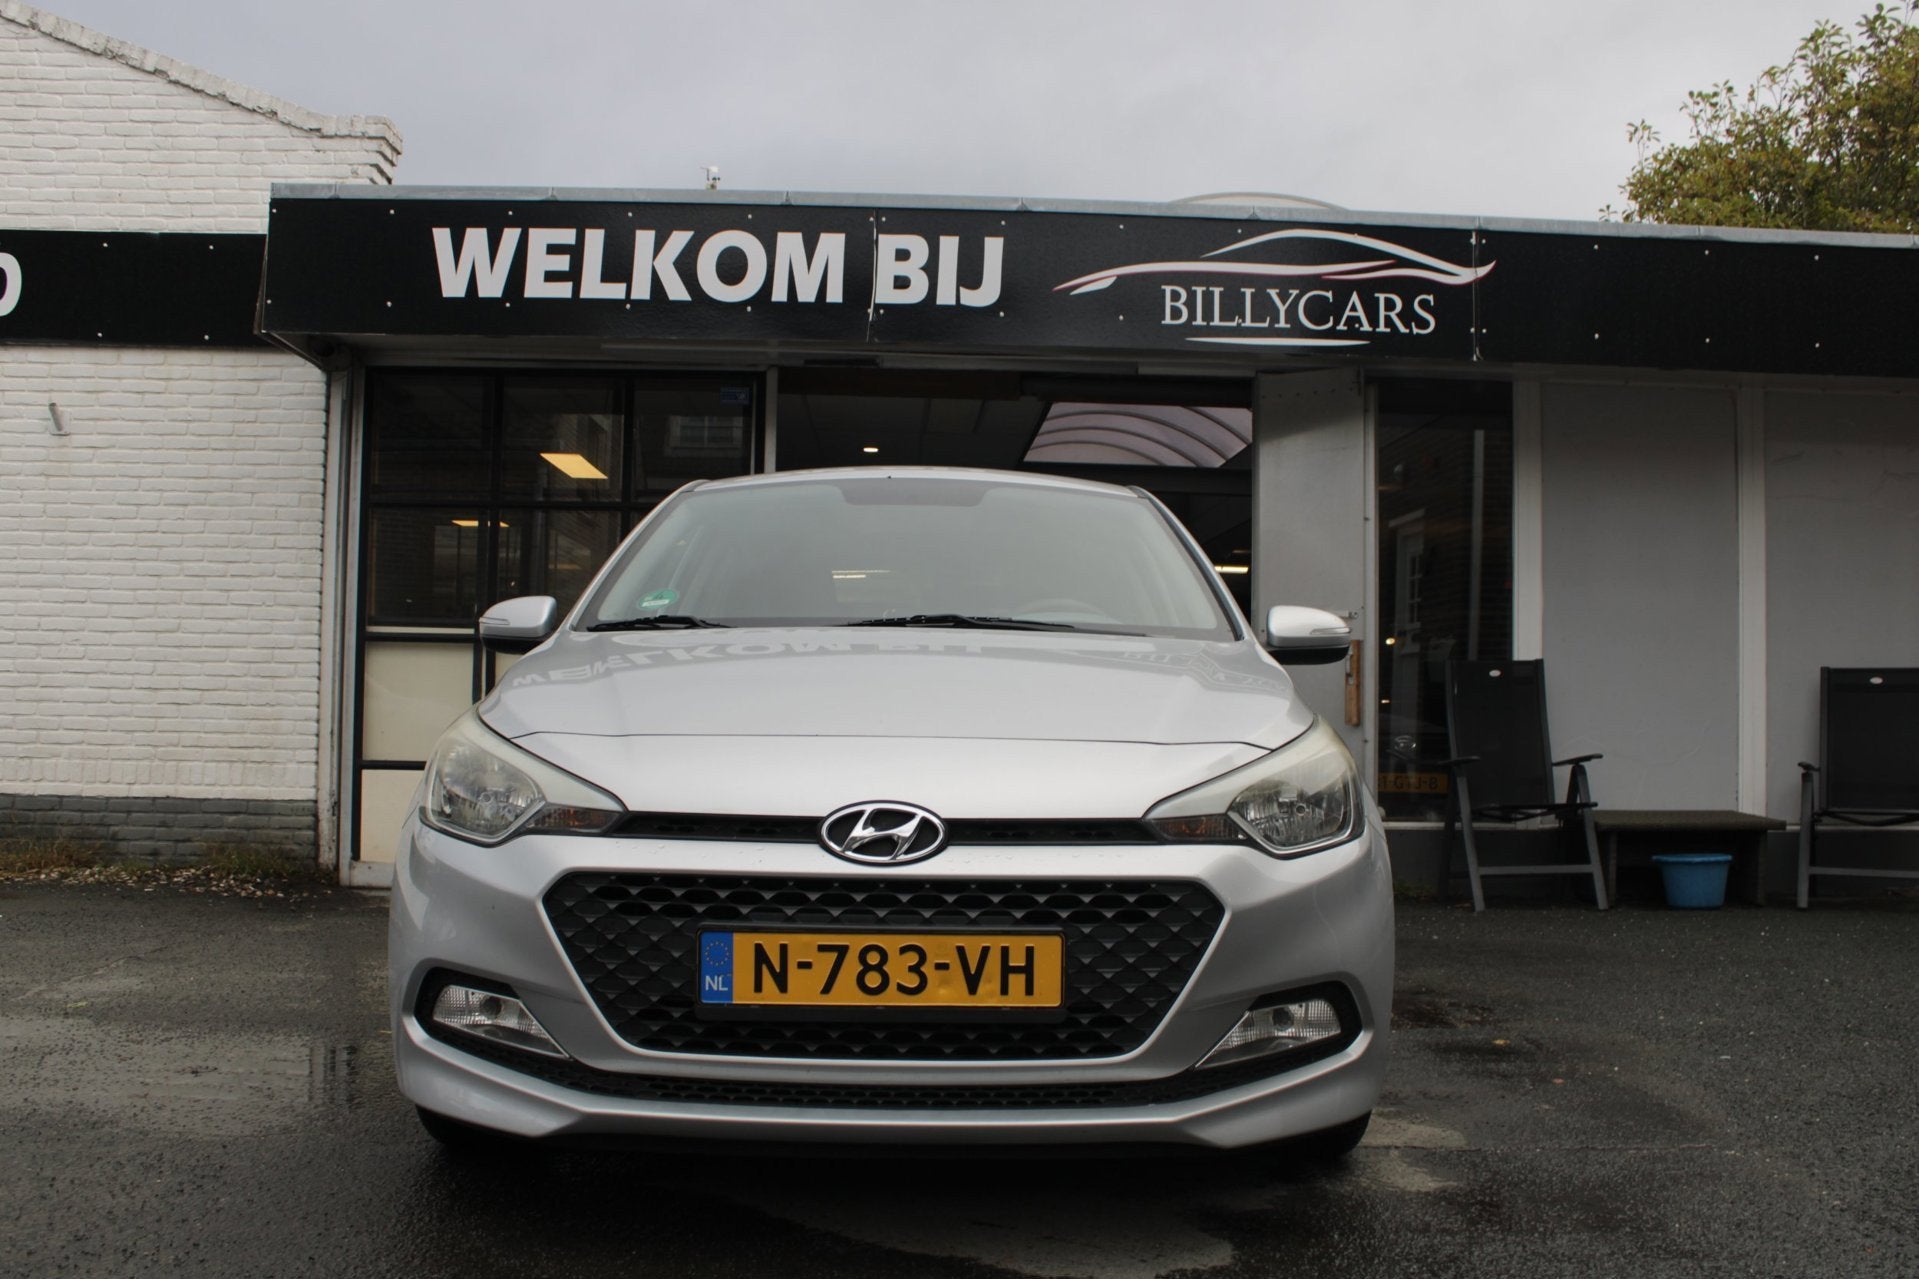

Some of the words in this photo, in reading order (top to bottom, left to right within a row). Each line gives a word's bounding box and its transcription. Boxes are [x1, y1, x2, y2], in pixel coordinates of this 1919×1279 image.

[431, 227, 846, 304] WELKOM
[874, 233, 1005, 308] BIJ
[1160, 284, 1436, 335] BILLYCARS
[704, 975, 729, 992] NL
[753, 941, 1035, 997] N-783-VH
